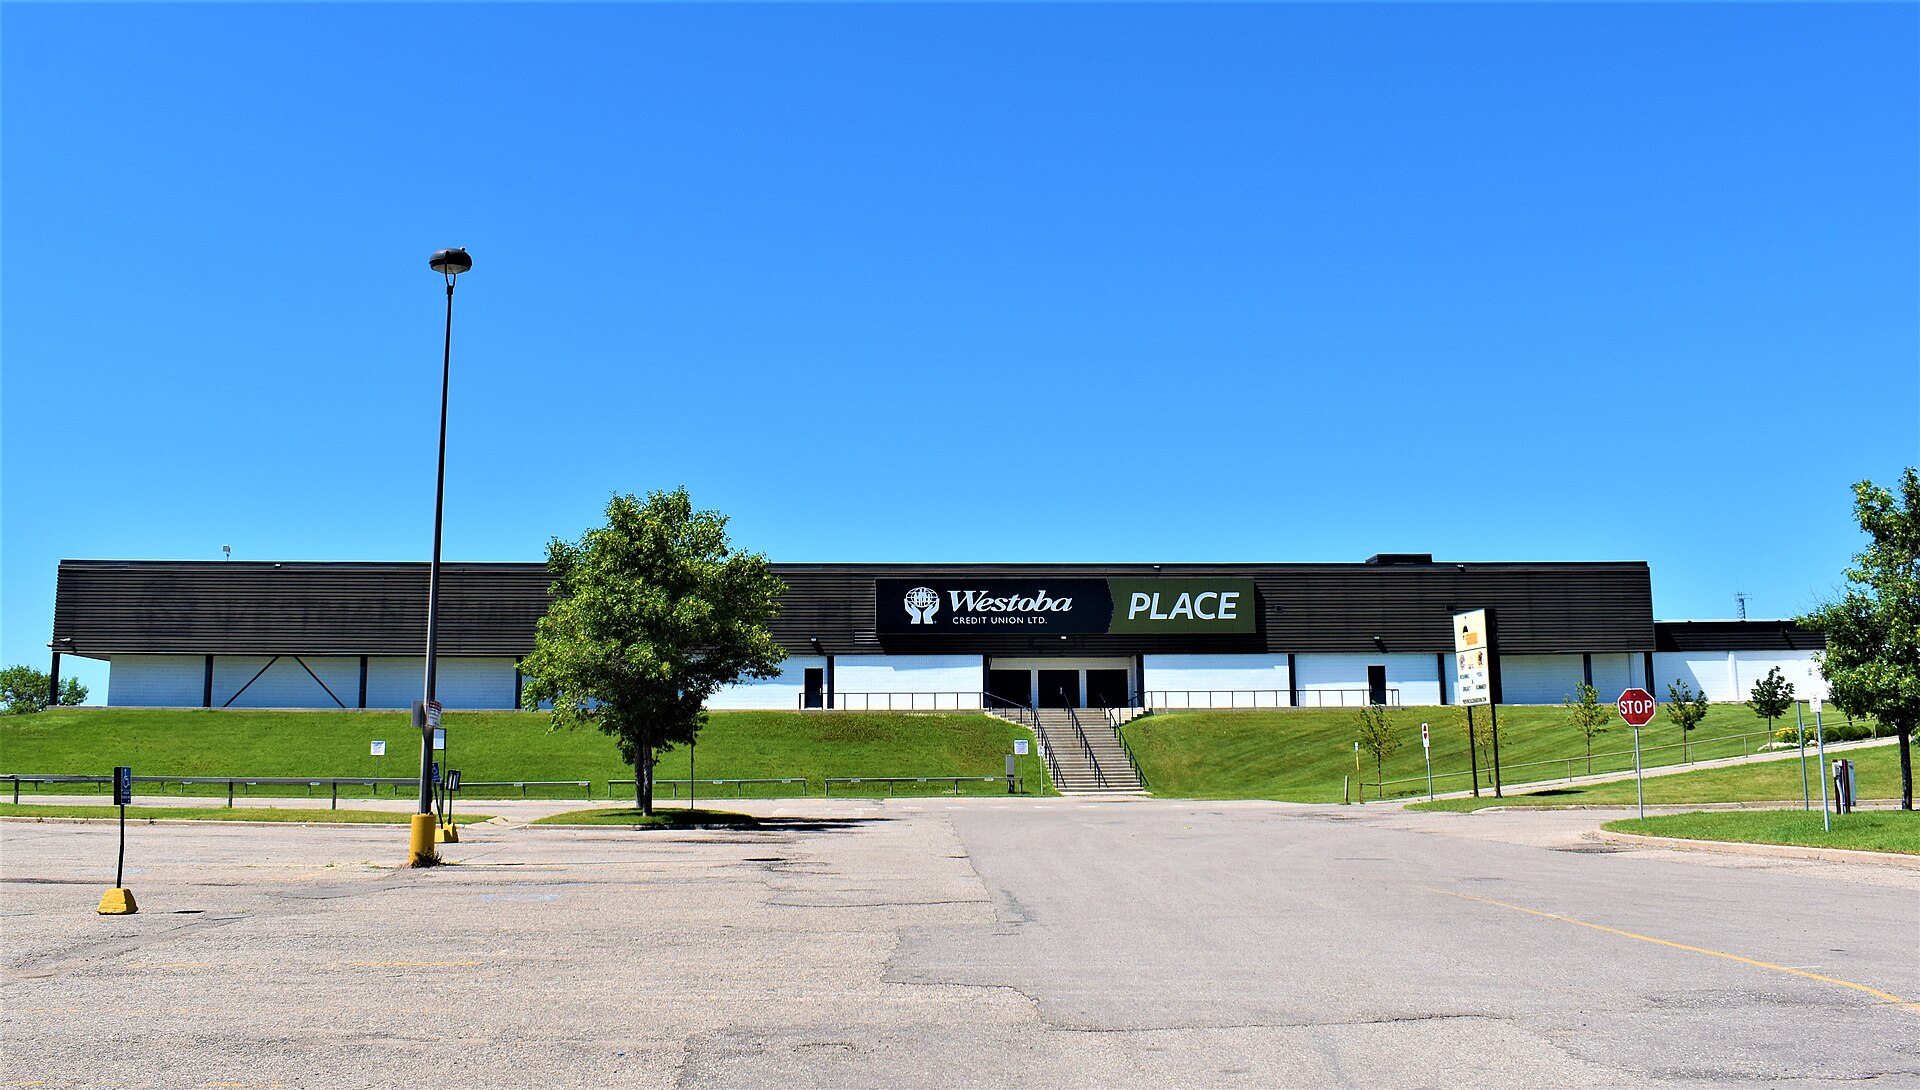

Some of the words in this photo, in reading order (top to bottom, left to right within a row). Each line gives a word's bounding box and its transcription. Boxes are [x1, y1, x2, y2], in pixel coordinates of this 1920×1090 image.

[947, 590, 1073, 612] Westoba
[1128, 591, 1240, 620] PLACE
[952, 616, 987, 625] CREDIT
[990, 616, 1024, 625] UNION
[1027, 616, 1048, 625] LTD.
[1620, 700, 1652, 714] STOP
